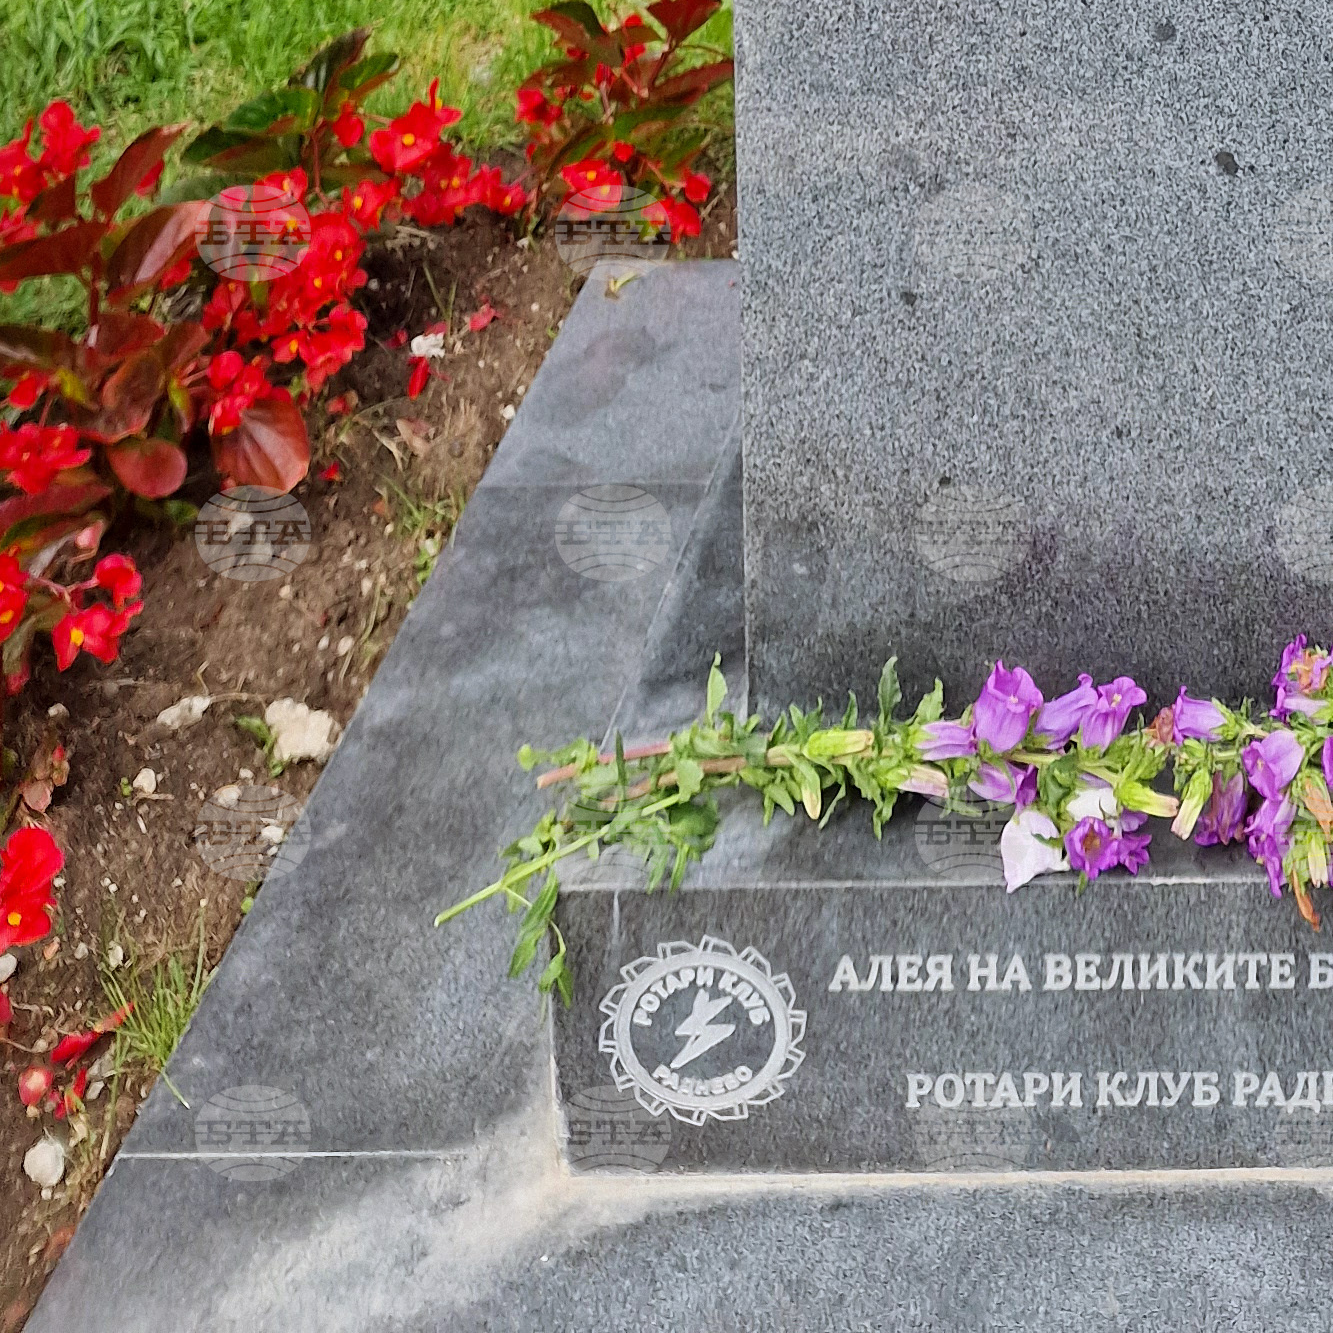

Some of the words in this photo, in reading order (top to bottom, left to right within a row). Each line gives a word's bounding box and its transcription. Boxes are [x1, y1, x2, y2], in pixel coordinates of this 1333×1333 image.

[827, 951, 956, 993] АЛЕЯ
[966, 951, 1033, 993] НА
[1042, 951, 1296, 992] ВЕЛИКИТЕ
[632, 966, 715, 1027] РОТАРИ
[904, 1070, 1084, 1112] РОТАРИ
[1096, 1070, 1221, 1110] КЛУБ
